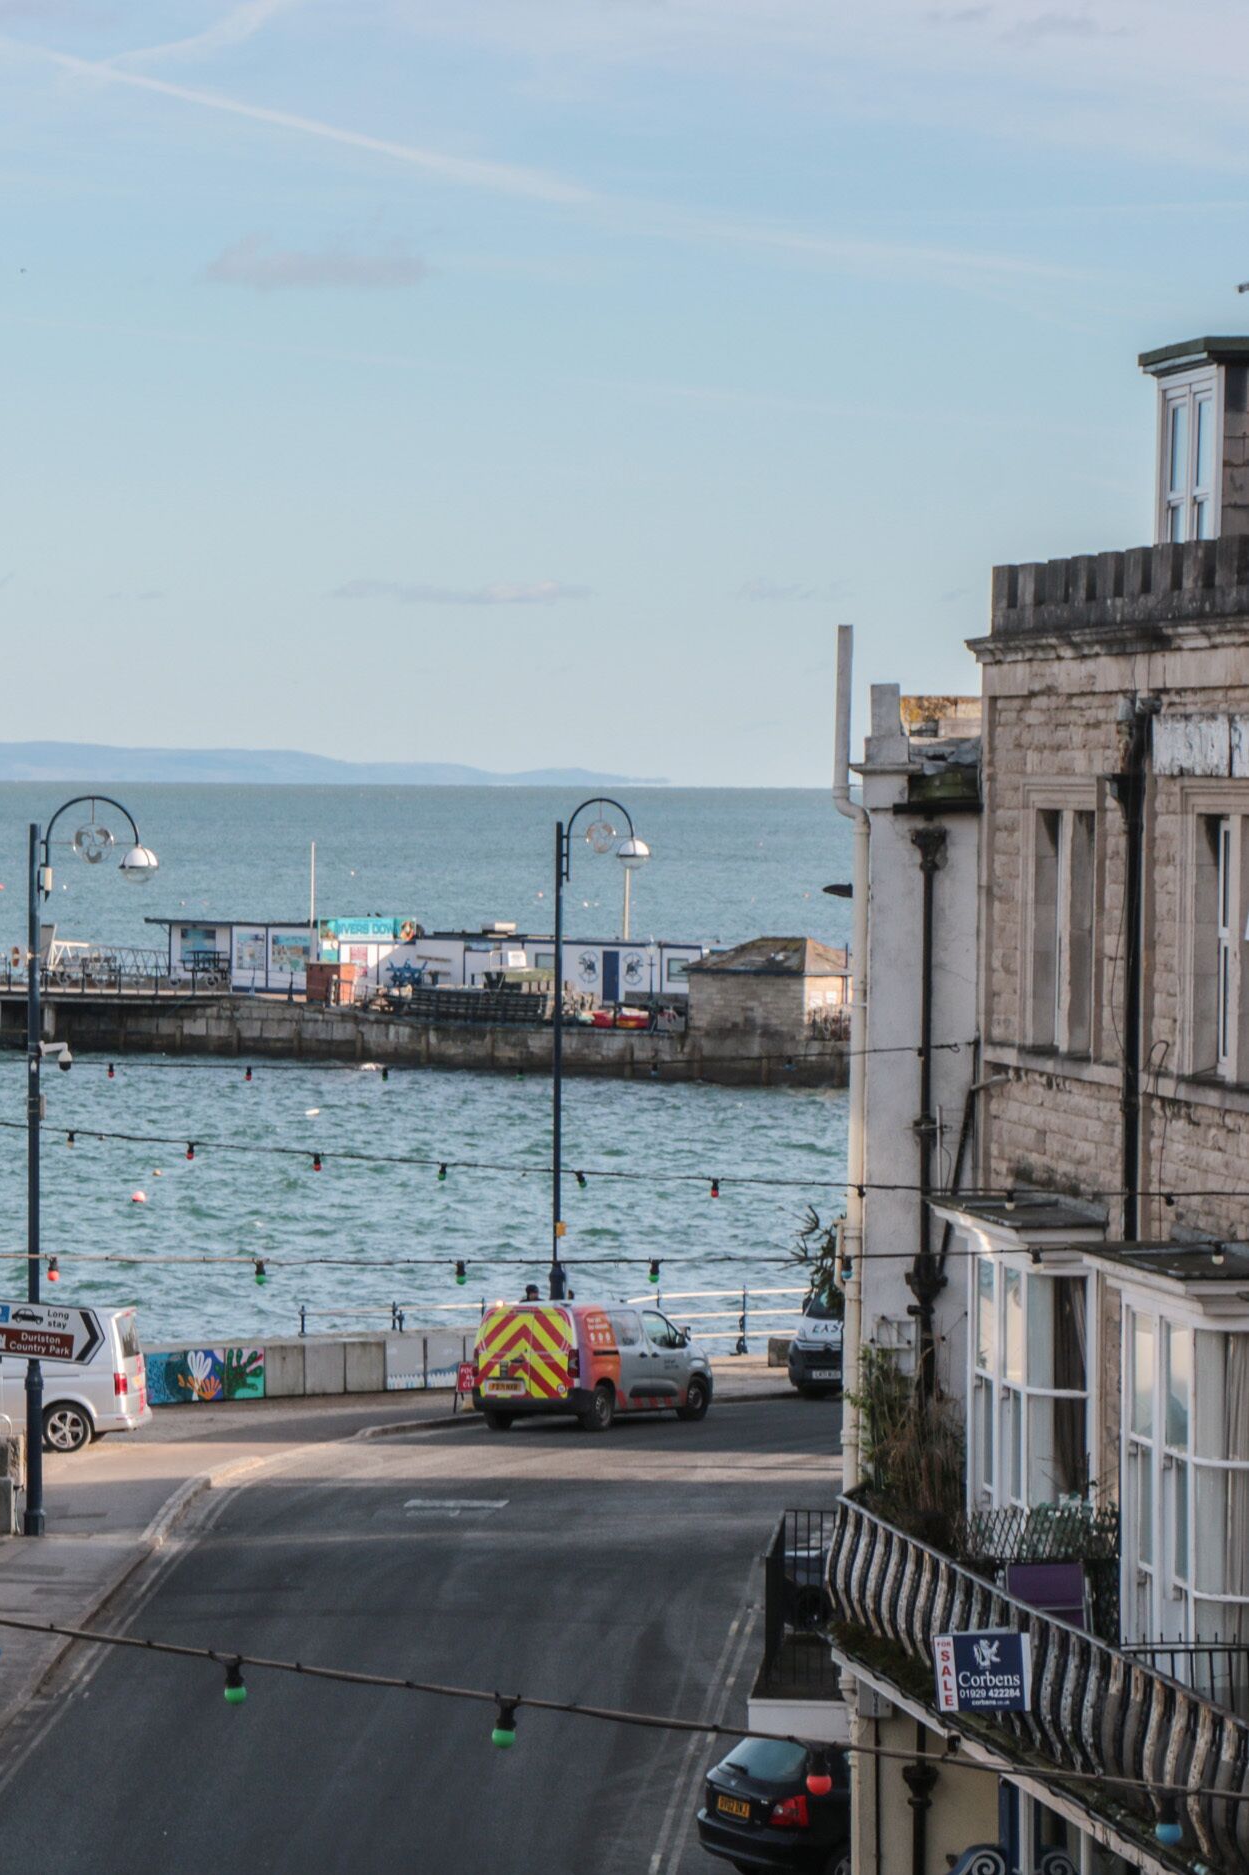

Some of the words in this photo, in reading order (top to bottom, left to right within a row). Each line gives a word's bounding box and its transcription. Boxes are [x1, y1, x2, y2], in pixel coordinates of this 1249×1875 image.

[47, 1310, 69, 1319] Long
[48, 1320, 67, 1330] stay
[21, 1332, 61, 1345] Durlston
[9, 1341, 47, 1354] Country
[49, 1345, 71, 1355] Park
[940, 1650, 954, 1707] SALE
[958, 1671, 1021, 1687] Corbens
[959, 1689, 987, 1698] 01929
[988, 1688, 1021, 1698] 422284
